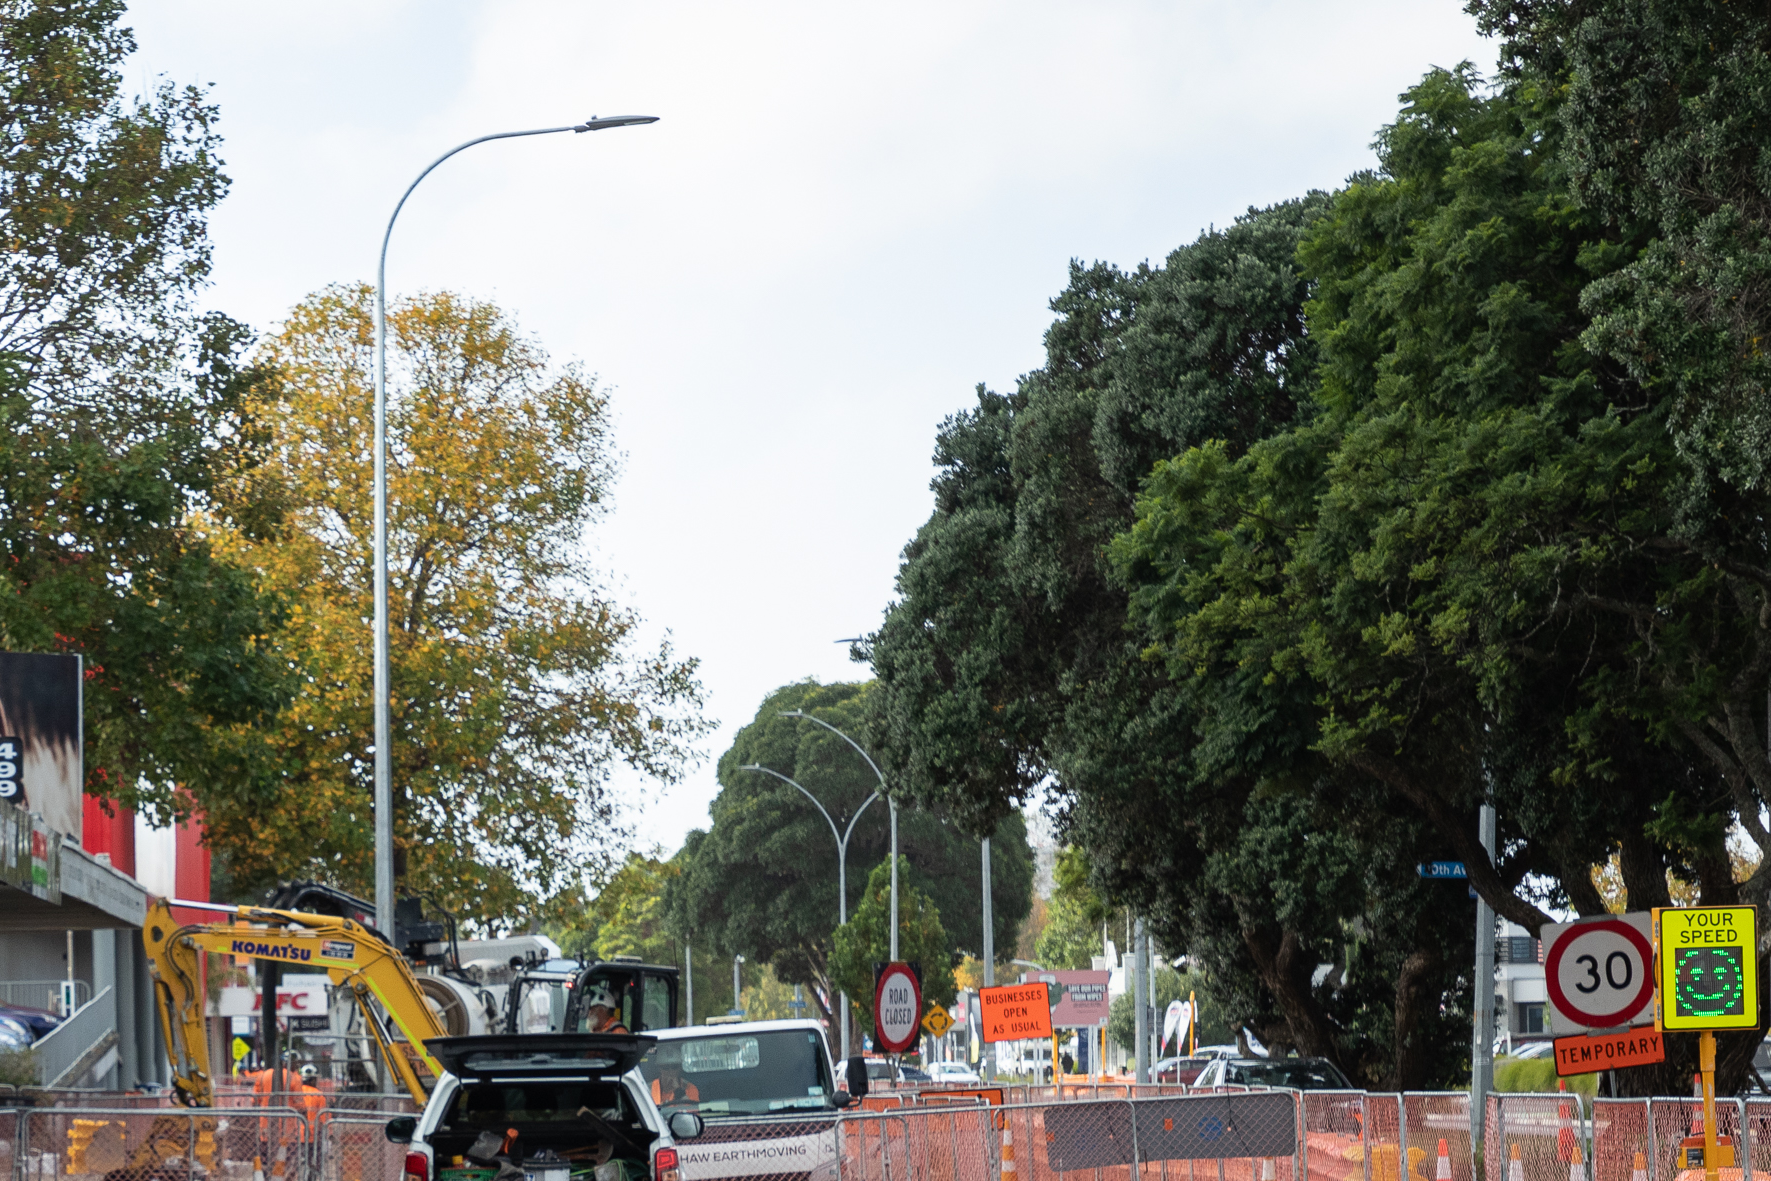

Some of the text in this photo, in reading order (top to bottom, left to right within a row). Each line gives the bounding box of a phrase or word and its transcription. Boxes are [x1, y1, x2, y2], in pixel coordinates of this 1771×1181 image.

[1683, 912, 1734, 927] YOUR
[1680, 929, 1738, 944] SPEED
[231, 940, 312, 961] KOMATSU
[1574, 950, 1633, 995] 30
[252, 992, 309, 1011] FC
[888, 988, 909, 1006] ROAD
[985, 989, 1043, 1006] BUSINESSES
[885, 1006, 912, 1026] CLOSED
[1002, 1007, 1029, 1019] OPEN
[992, 1020, 1042, 1035] AS USUAL
[1559, 1036, 1660, 1065] TEMPORARY
[713, 1145, 807, 1162] EARTHMOVING
